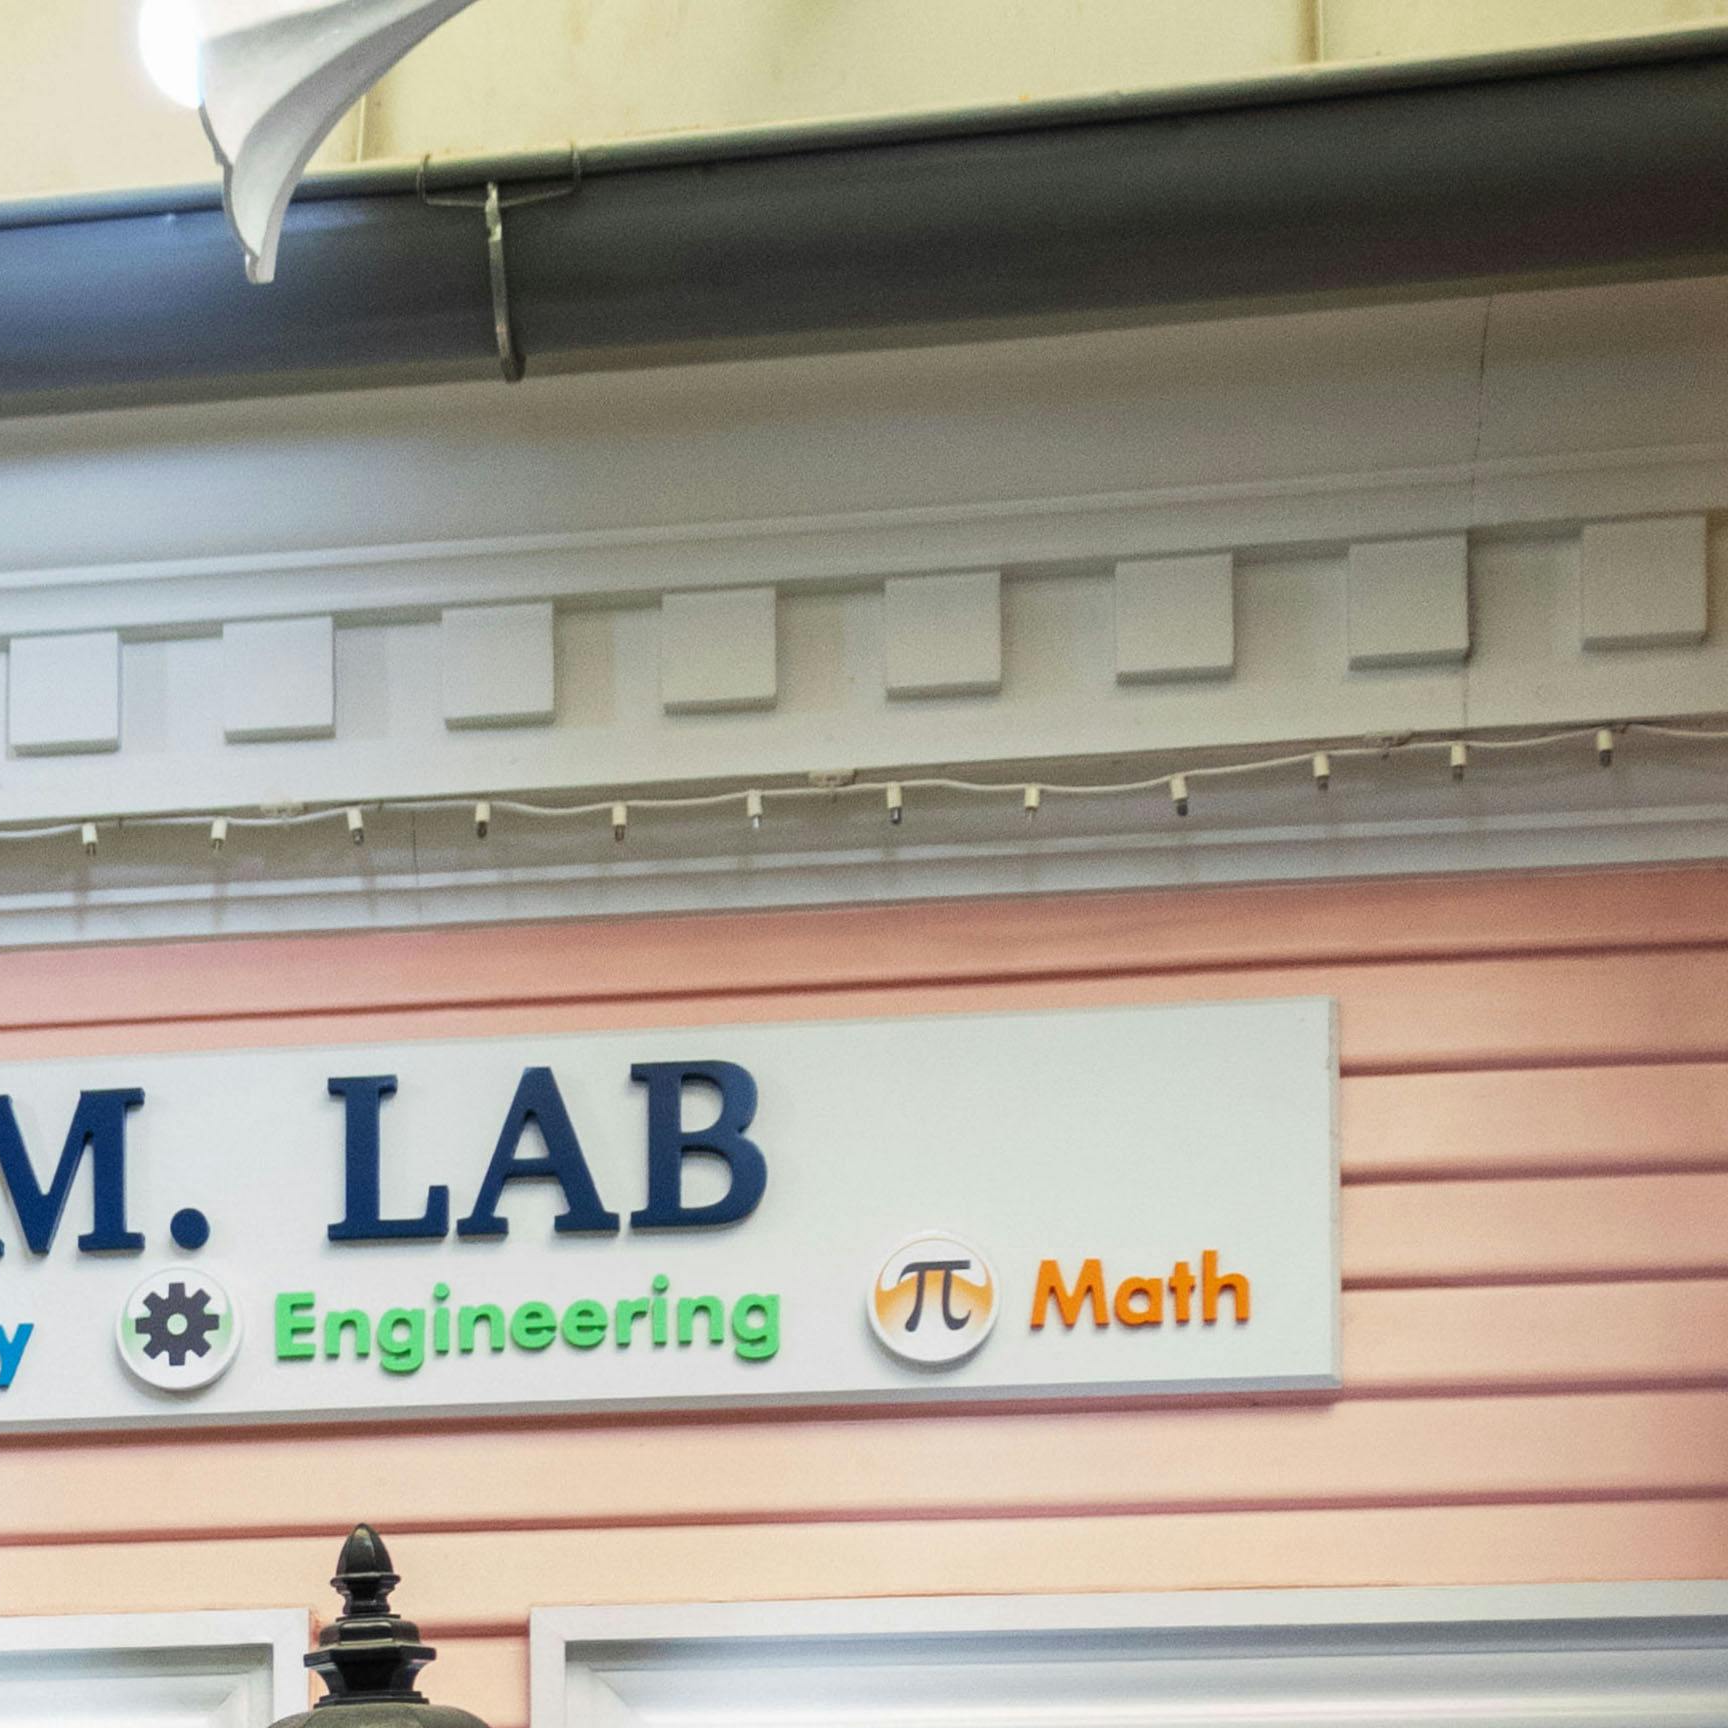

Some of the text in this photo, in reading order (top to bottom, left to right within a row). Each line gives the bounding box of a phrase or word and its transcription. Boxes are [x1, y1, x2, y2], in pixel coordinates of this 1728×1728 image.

[326, 1059, 768, 1242] LAB
[274, 1273, 780, 1373] Engineering
[1030, 1250, 1251, 1329] Math
